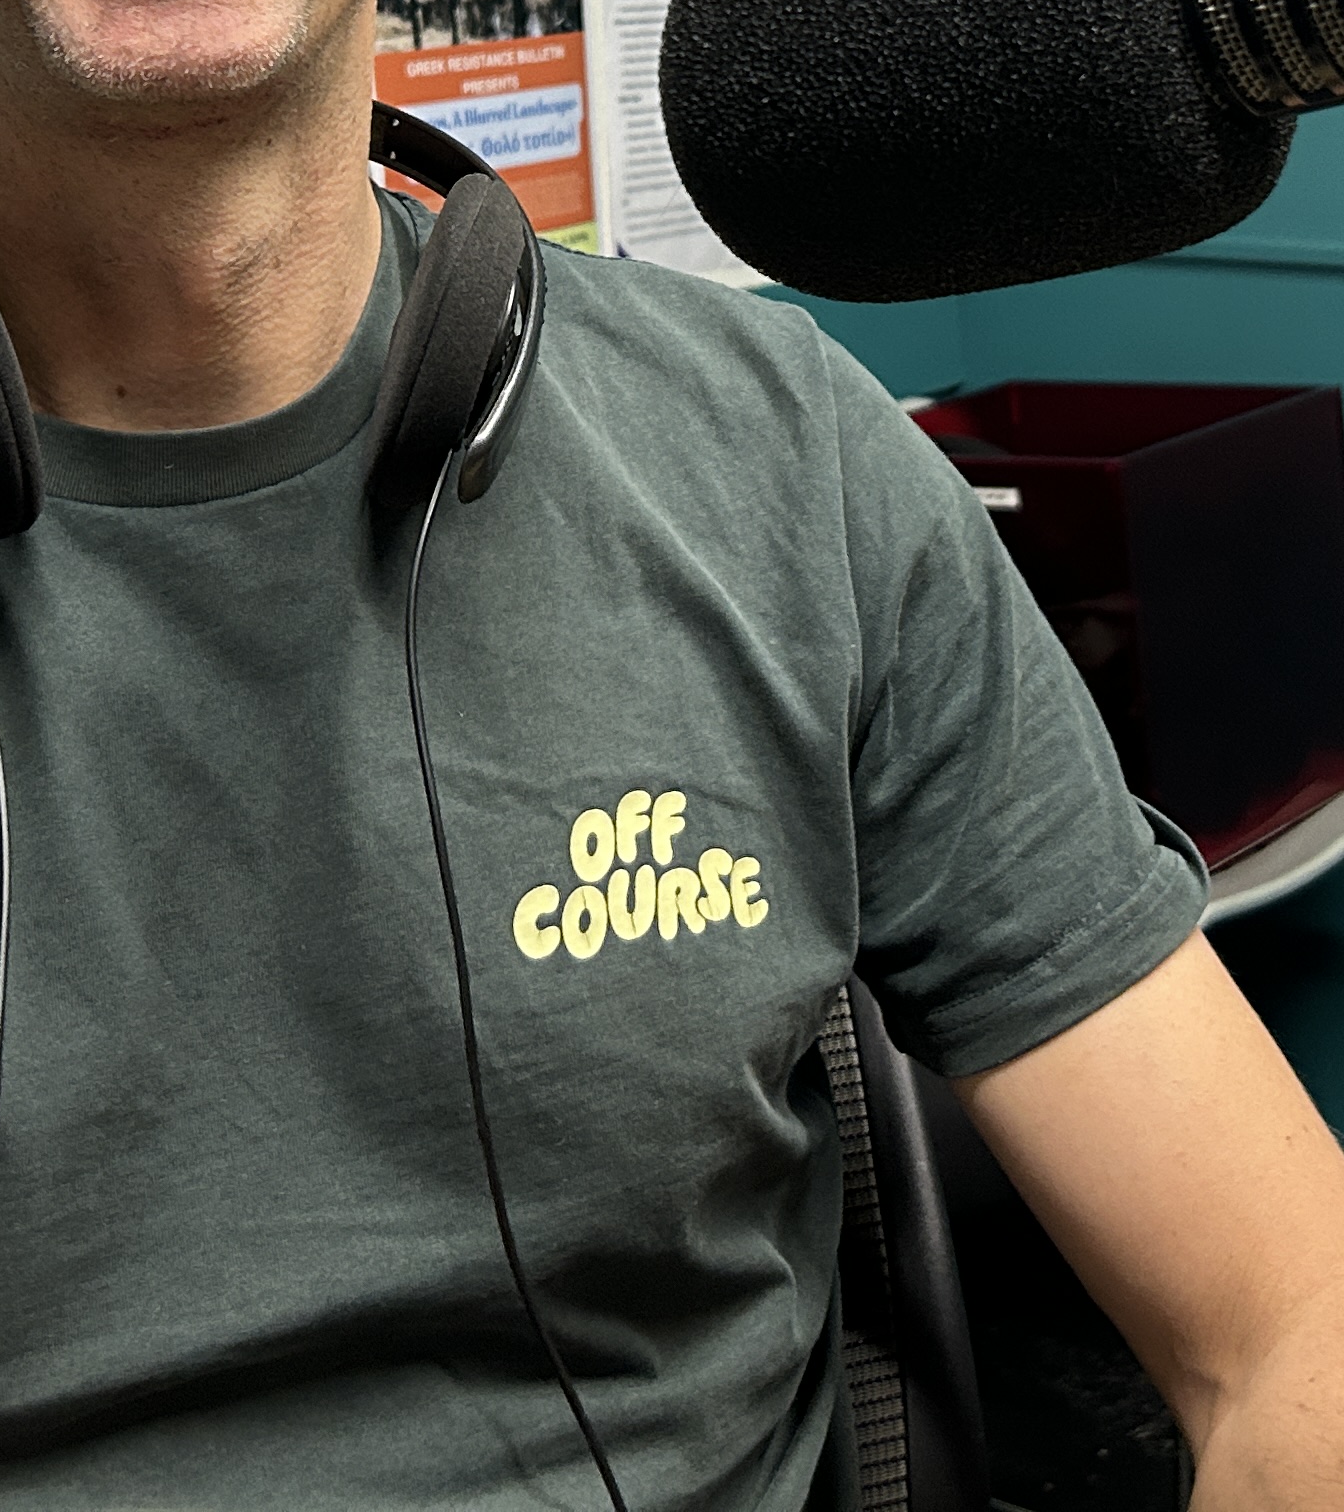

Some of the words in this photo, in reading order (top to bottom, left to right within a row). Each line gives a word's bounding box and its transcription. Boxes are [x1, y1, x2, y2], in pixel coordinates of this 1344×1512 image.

[407, 59, 445, 78] GREEK
[448, 51, 515, 72] RESISTANCE
[517, 45, 564, 64] BULLETIN
[463, 75, 524, 95] PRESENTS
[570, 789, 687, 883] OFF
[513, 847, 769, 960] COURSE
